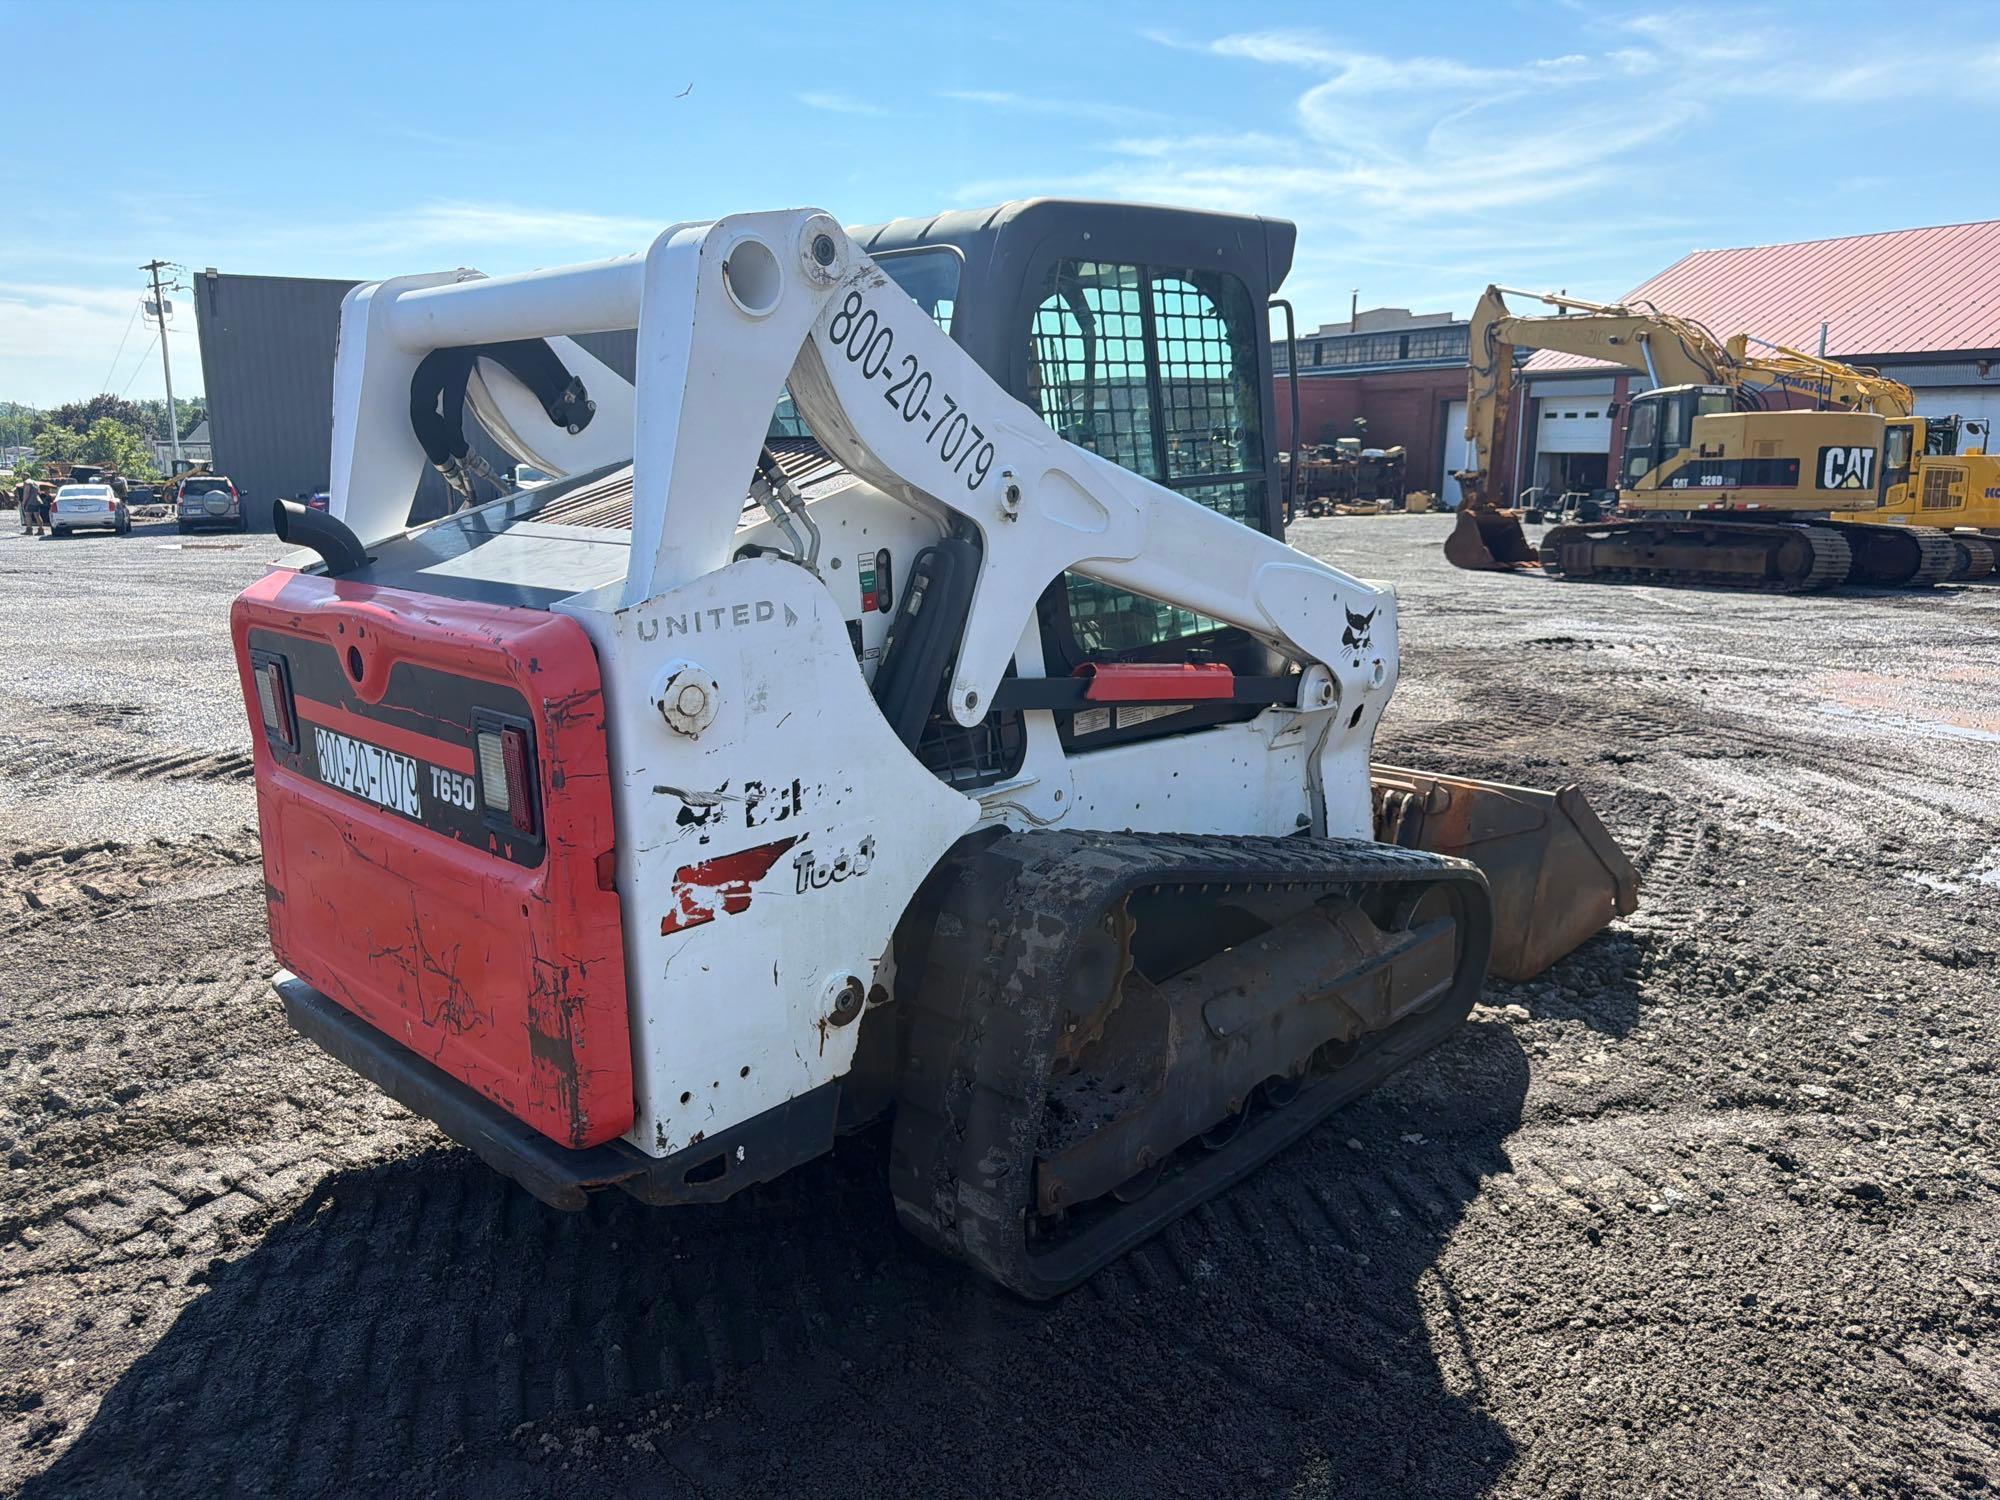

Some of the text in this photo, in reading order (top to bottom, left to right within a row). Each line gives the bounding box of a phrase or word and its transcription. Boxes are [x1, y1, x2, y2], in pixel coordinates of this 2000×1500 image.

[829, 290, 995, 491] 800-20-7079
[1672, 478, 1689, 489] CAT
[1824, 447, 1874, 490] CAT
[637, 600, 776, 642] UNITED
[315, 728, 475, 817] 800-20-7079 T650
